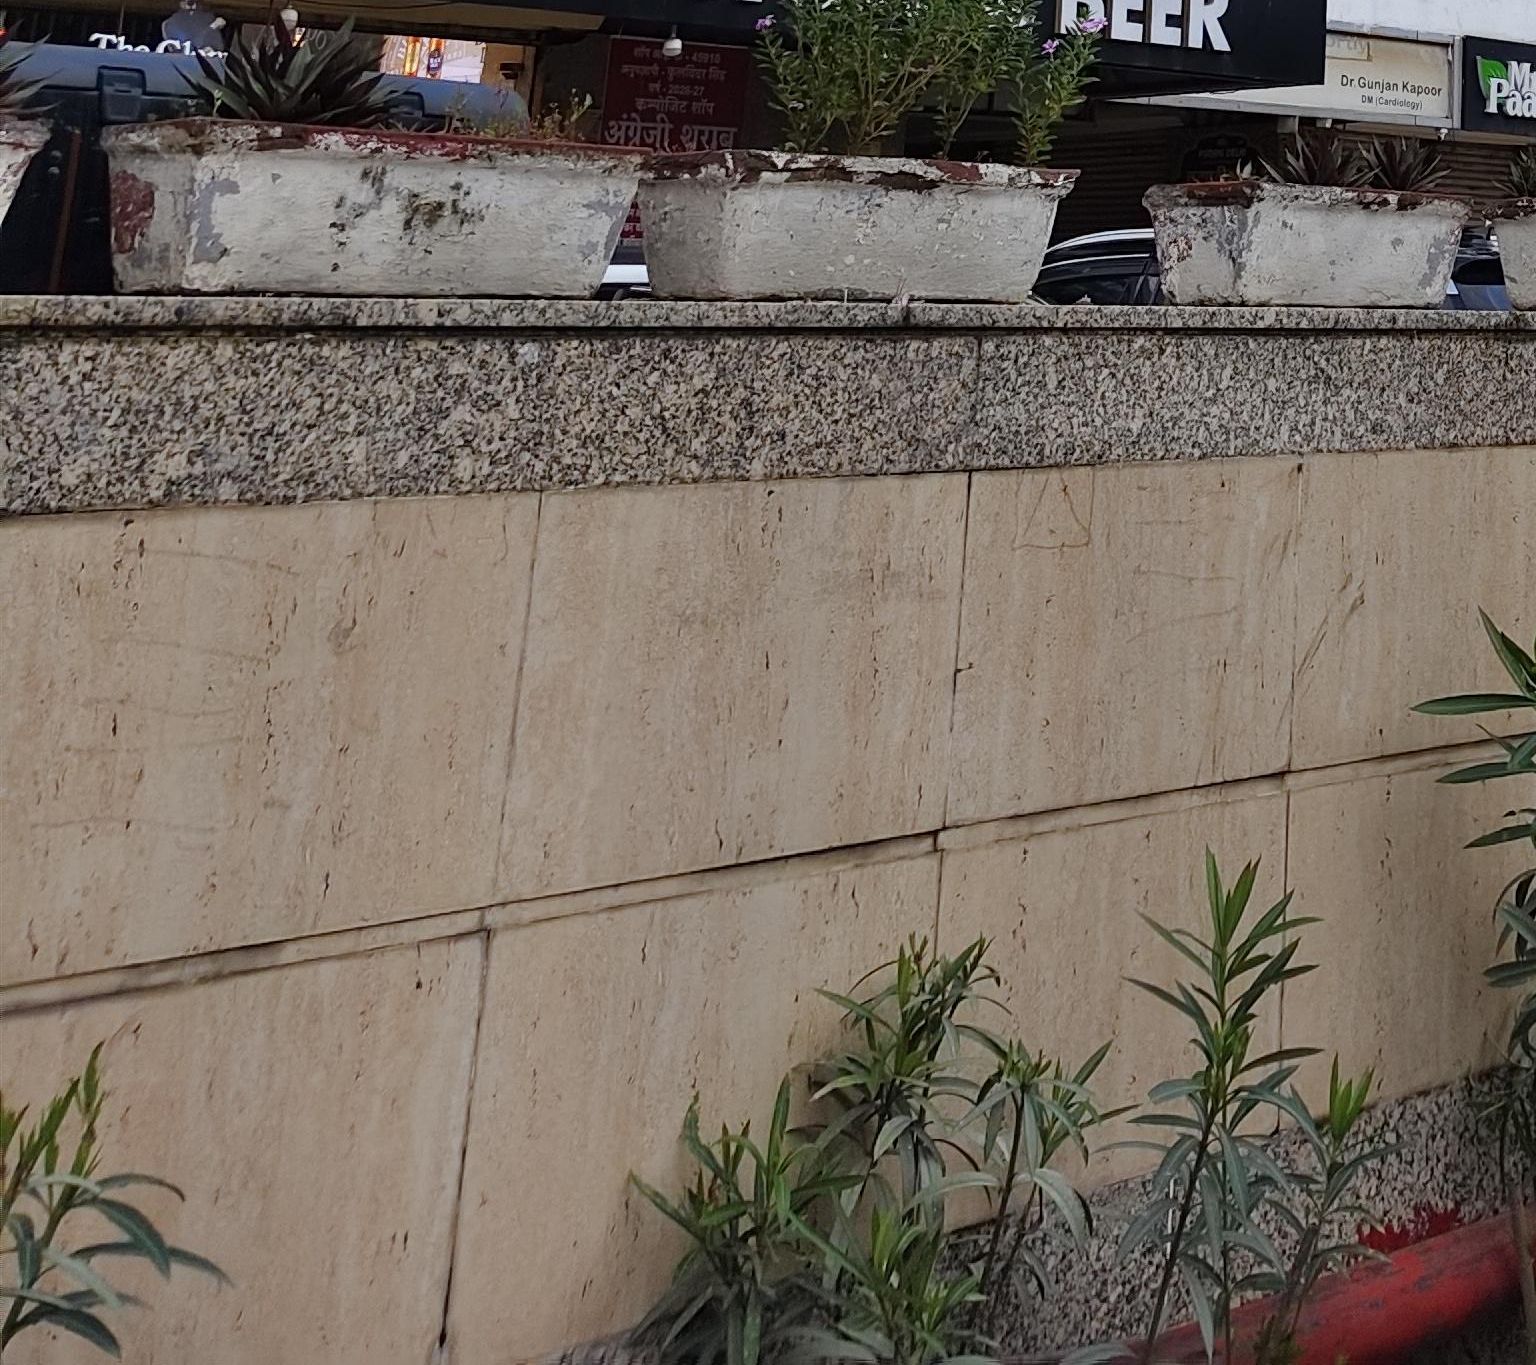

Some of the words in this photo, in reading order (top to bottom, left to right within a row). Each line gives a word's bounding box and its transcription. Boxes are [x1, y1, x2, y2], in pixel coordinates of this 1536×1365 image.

[1402, 81, 1442, 97] Kapoor
[1361, 94, 1373, 104] DM
[1375, 96, 1423, 110] (Cardiology)
[680, 125, 738, 151] शराब
